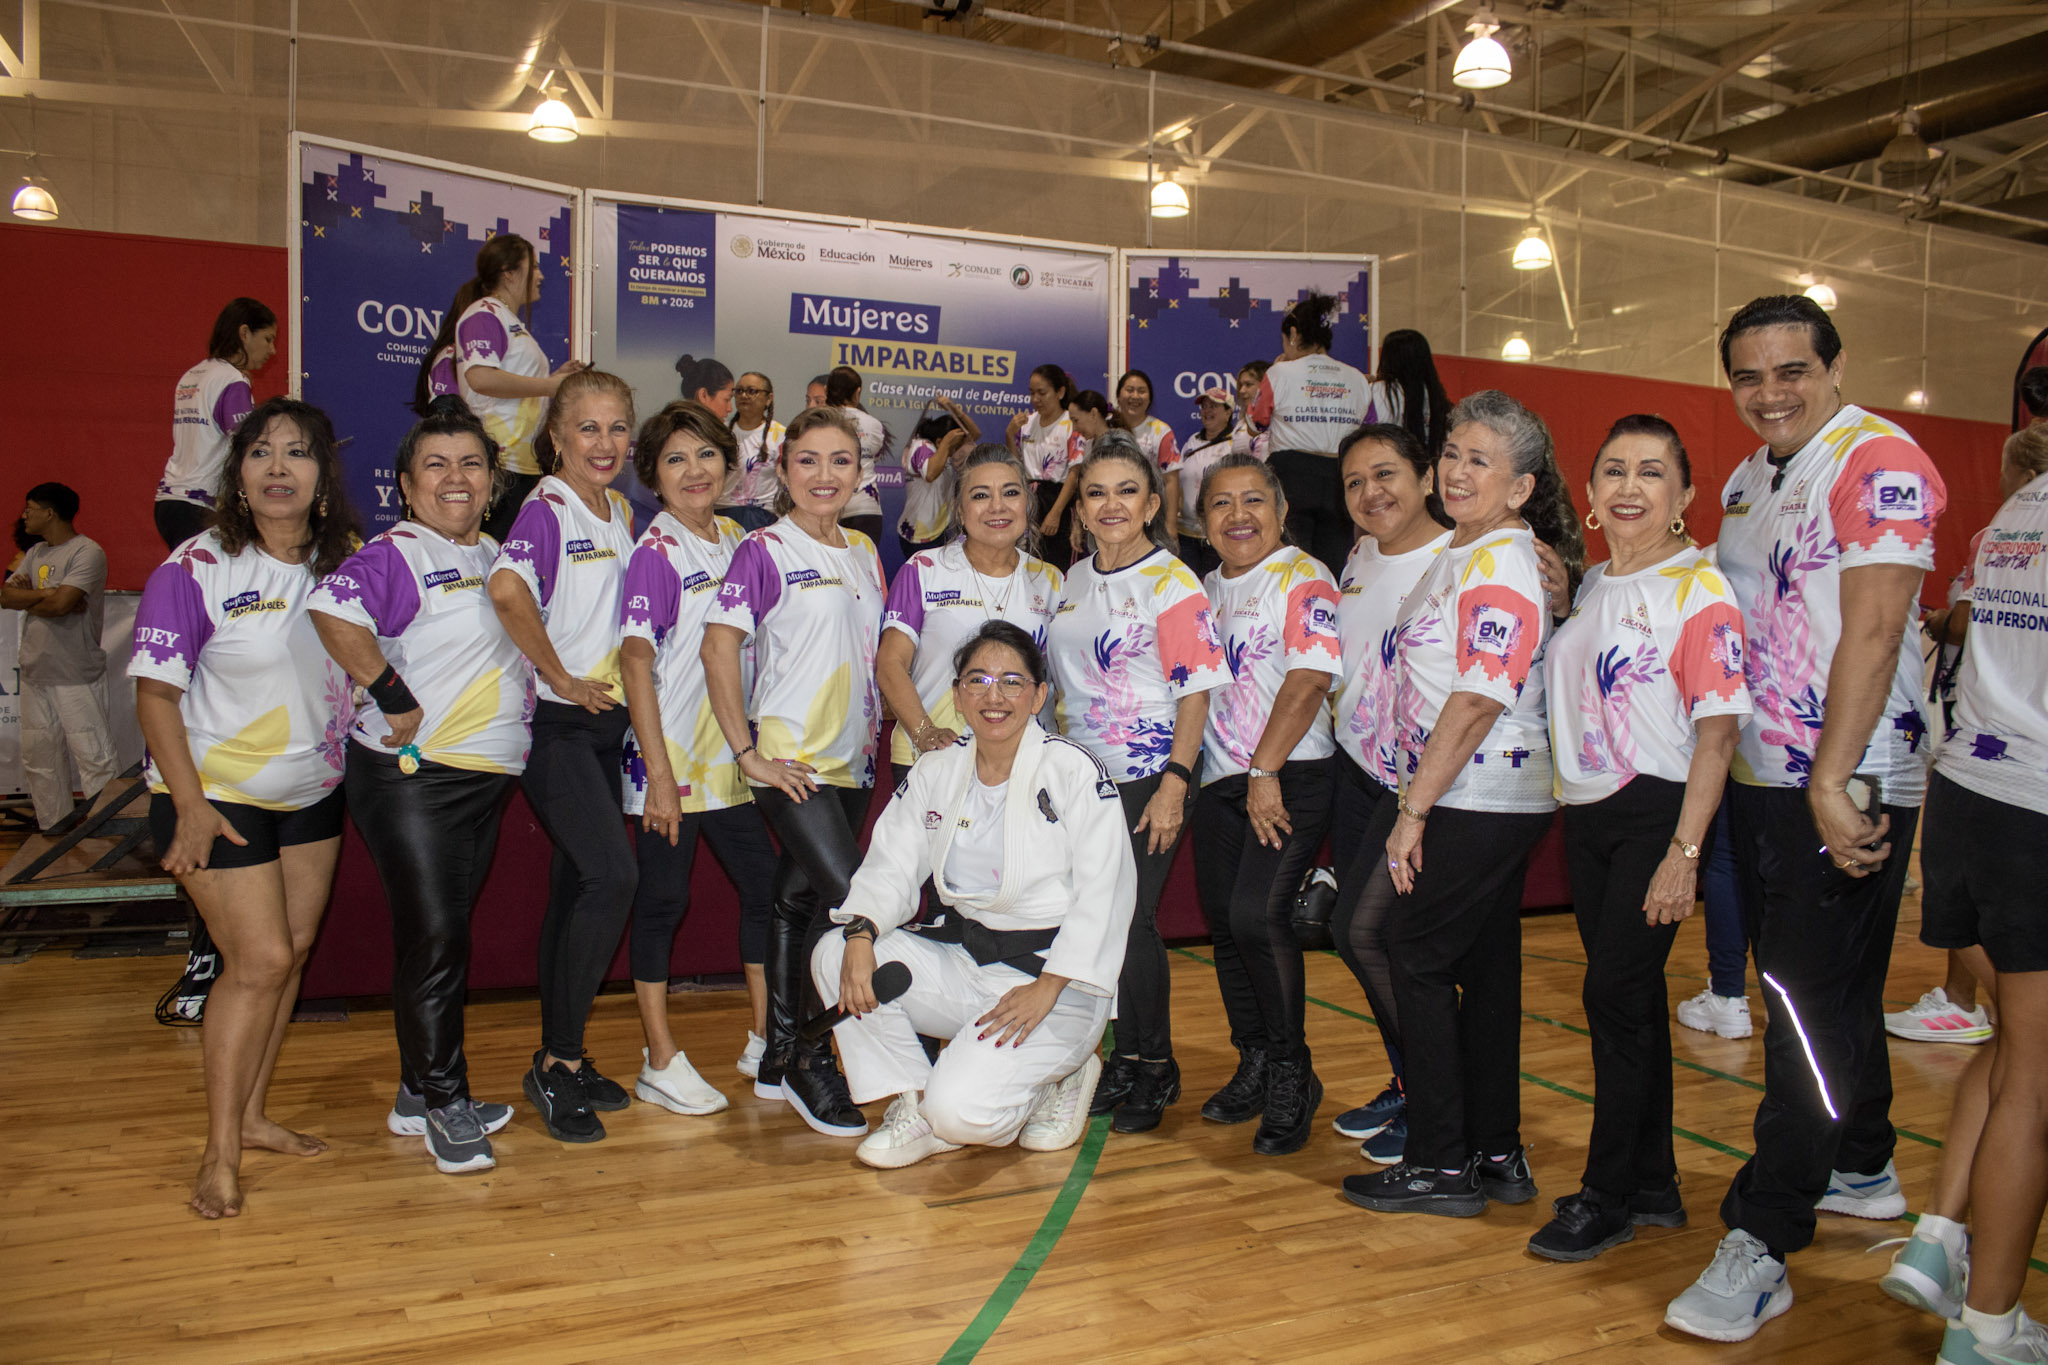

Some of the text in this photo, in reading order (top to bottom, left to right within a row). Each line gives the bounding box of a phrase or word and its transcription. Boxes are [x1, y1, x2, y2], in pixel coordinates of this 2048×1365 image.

[651, 243, 707, 257] PODEMOS
[757, 238, 795, 250] Gobierno
[757, 245, 805, 262] México
[819, 248, 875, 262] Educación
[638, 254, 660, 266] SER
[672, 257, 697, 269] QUE
[889, 254, 933, 269] Mujeres
[629, 267, 706, 284] QUERAMOS
[964, 264, 1001, 276] CONADE
[1057, 276, 1094, 288] YUCATÁN
[641, 295, 694, 308] 8M 2026
[357, 300, 443, 340] CON
[802, 297, 929, 336] Mujeres
[386, 342, 430, 355] COMISIÓ
[466, 339, 491, 351] IDEY
[377, 352, 422, 366] CULTURA
[838, 343, 1010, 378] IMPARABLES
[1174, 371, 1238, 398] CON
[869, 381, 1031, 405] Clase Nacional de Defensa
[869, 398, 890, 408] POR
[893, 399, 906, 409] LA
[965, 404, 973, 413] Y
[975, 405, 1015, 416] CONTRA
[1295, 406, 1357, 415] CLASE NACIONAL
[1295, 415, 1328, 423] DEFENSA
[1879, 486, 1917, 503] 8M
[320, 574, 360, 590] DEY
[721, 582, 746, 598] EY
[1479, 620, 1507, 640] 8M
